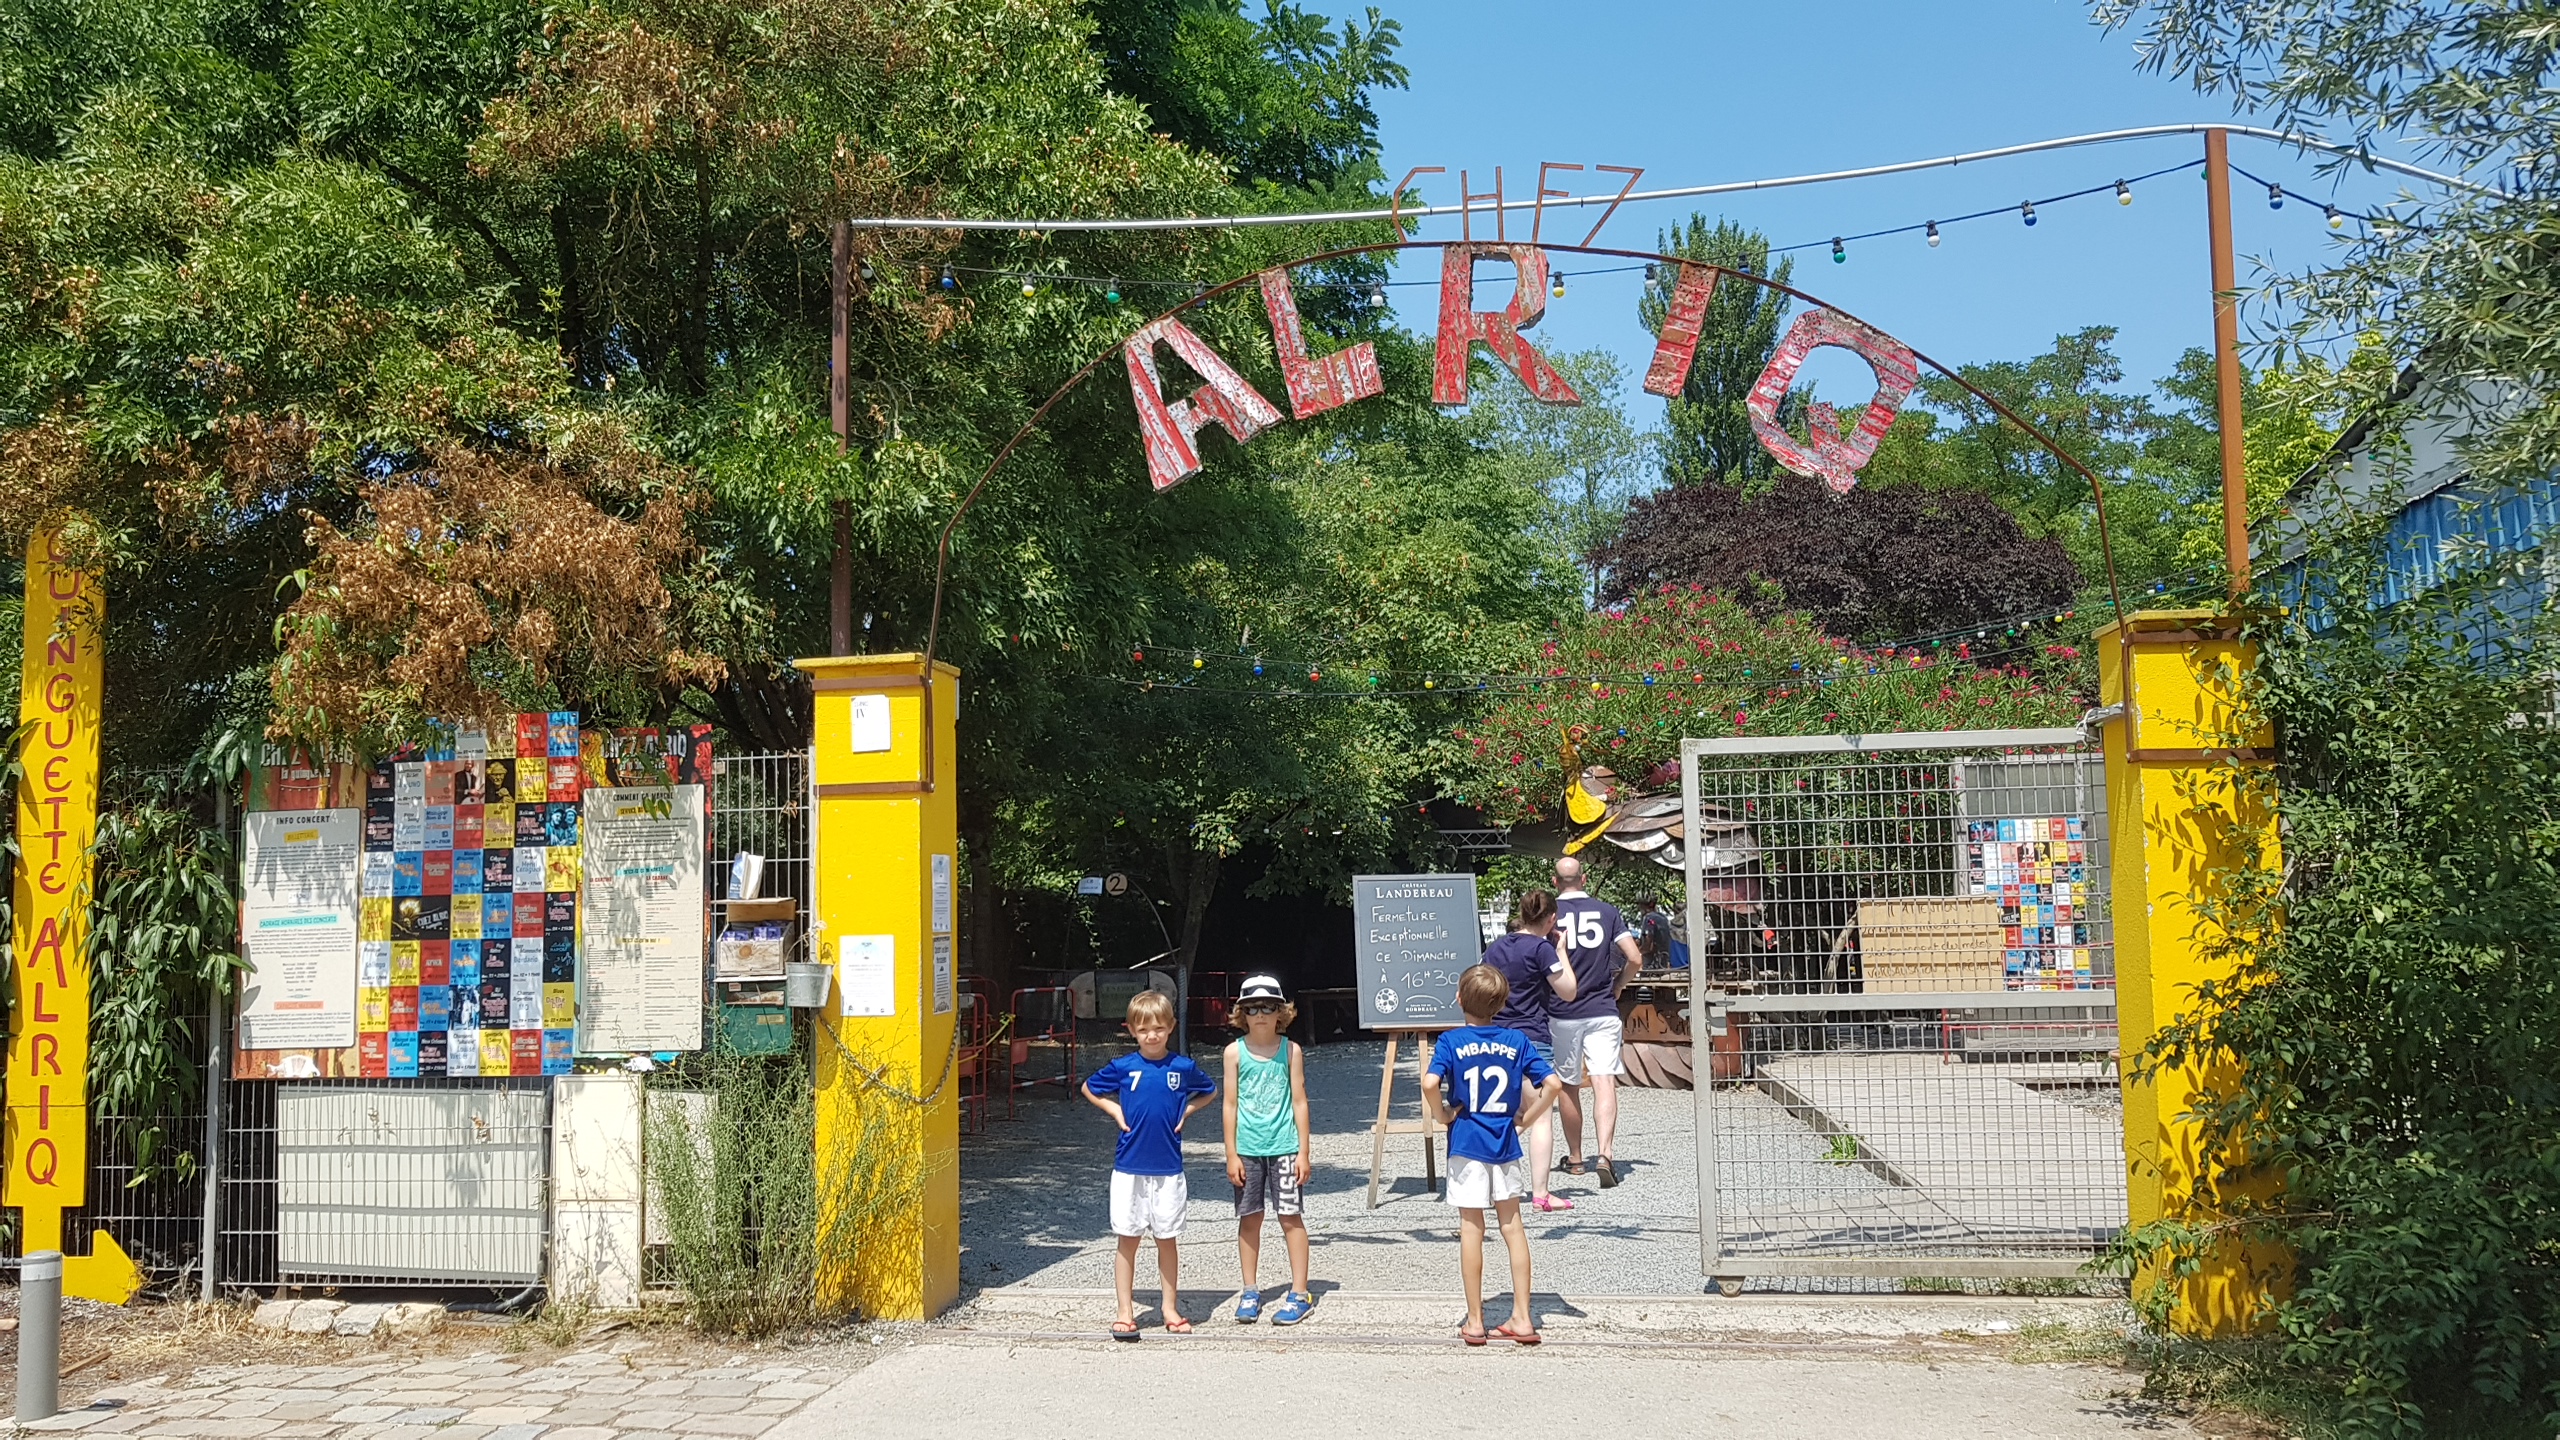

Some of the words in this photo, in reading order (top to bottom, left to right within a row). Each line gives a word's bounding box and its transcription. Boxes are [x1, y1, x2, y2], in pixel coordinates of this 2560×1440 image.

[1124, 241, 1918, 494] ALRIQ
[276, 816, 293, 825] INFO
[296, 815, 330, 824] CONCERT
[1110, 876, 1124, 892] 2
[1376, 887, 1453, 899] LANDEREAU
[1557, 911, 1604, 950] 15
[1376, 952, 1391, 963] CE
[26, 917, 68, 1187] ALRIQ
[1455, 1041, 1518, 1061] MBAPPE
[1129, 1071, 1142, 1091] 7
[1463, 1065, 1508, 1113] 12
